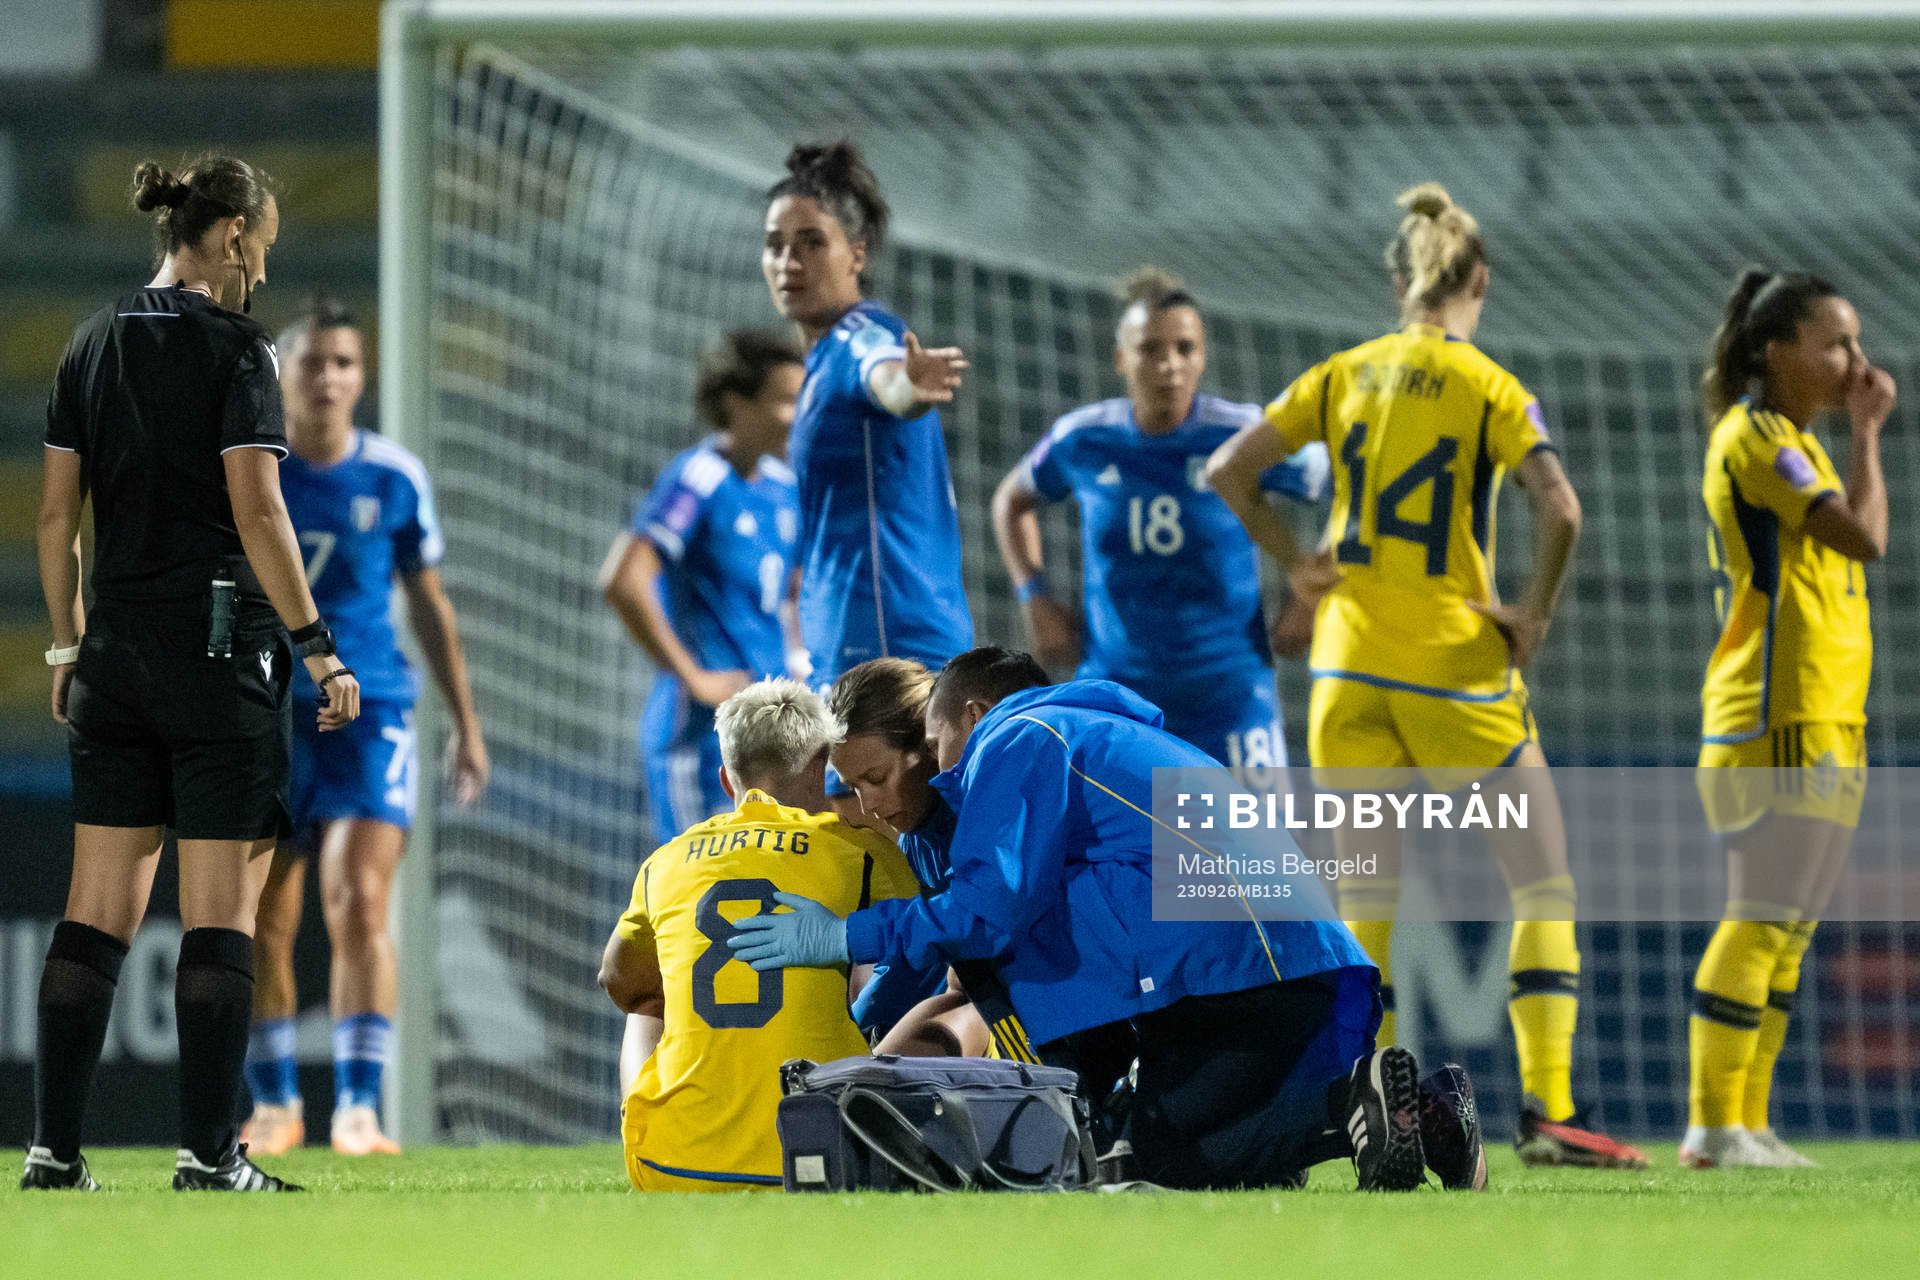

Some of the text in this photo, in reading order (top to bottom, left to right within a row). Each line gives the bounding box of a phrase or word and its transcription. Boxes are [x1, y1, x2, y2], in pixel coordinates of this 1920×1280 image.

[1129, 494, 1184, 556] 18
[1337, 421, 1459, 577] 14
[300, 530, 336, 588] 7
[381, 726, 411, 784] 7
[1226, 727, 1277, 790] 18
[685, 829, 809, 863] HURTIG
[692, 878, 783, 1029] 8
